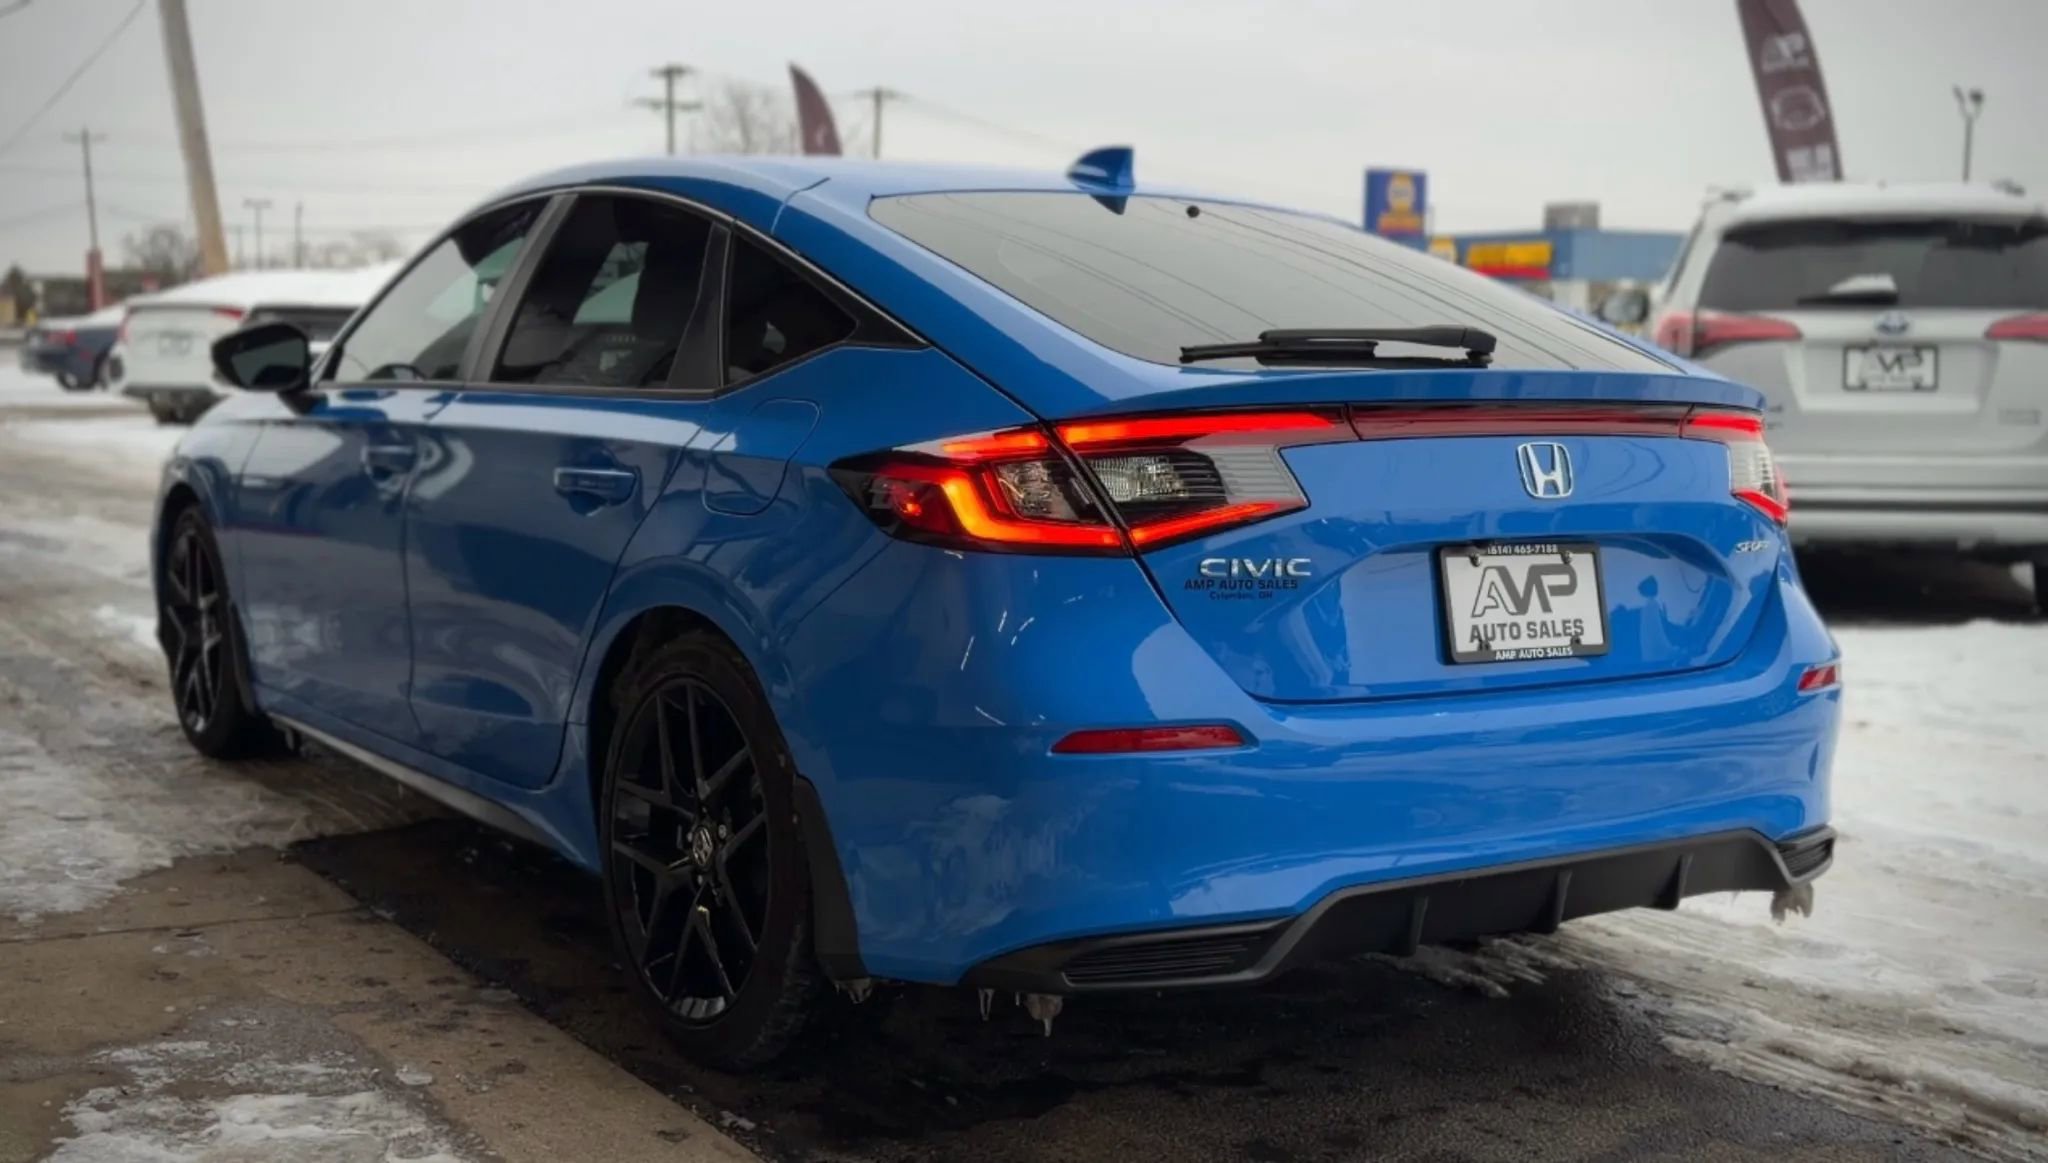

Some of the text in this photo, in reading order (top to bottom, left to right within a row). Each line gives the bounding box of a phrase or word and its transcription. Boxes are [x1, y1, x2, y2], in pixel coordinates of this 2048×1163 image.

[1200, 558, 1311, 577] CIVIC
[1184, 579, 1298, 590] AMP AUTO SALES
[1471, 563, 1577, 618] AMP
[1469, 618, 1584, 643] AUTO SALES
[1495, 646, 1573, 660] AMP AUTO SALES
